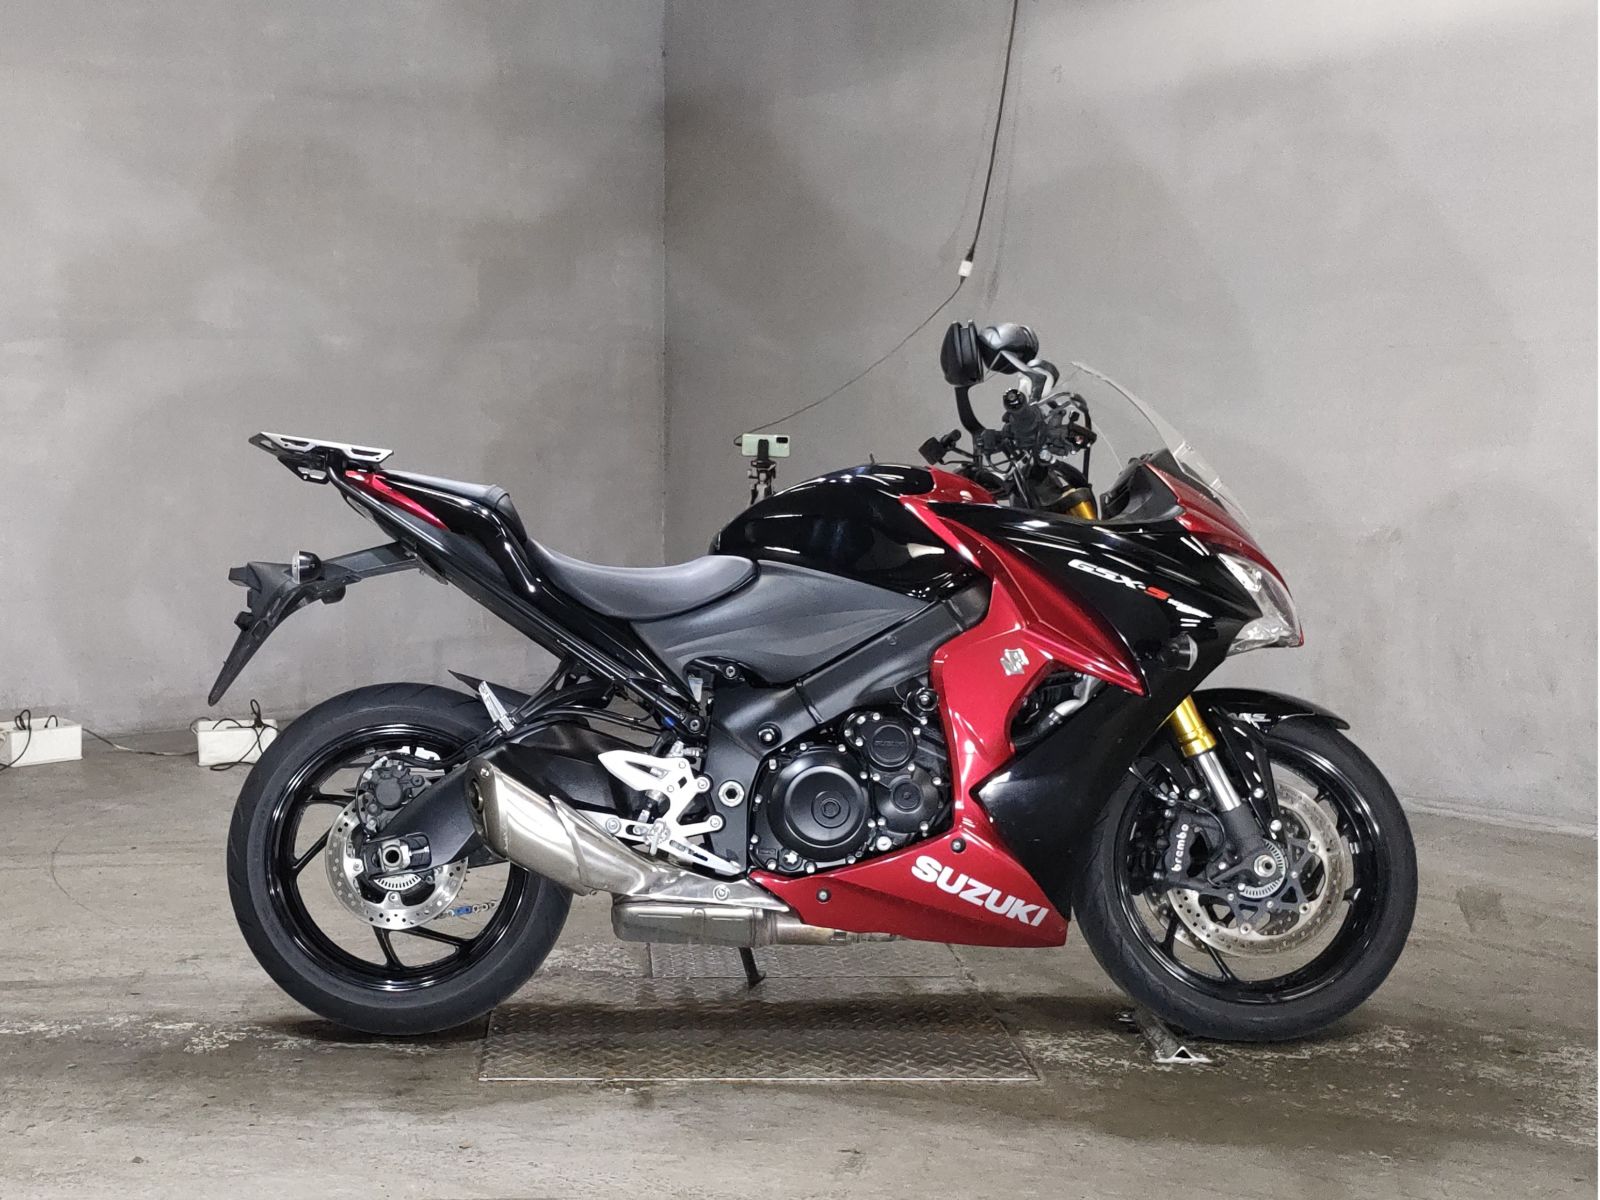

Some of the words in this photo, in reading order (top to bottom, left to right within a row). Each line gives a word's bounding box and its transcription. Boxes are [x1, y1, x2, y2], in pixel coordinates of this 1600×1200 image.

[1068, 559, 1171, 600] GSX-S
[1171, 823, 1189, 872] brembo
[911, 855, 1049, 927] SUZUKI
